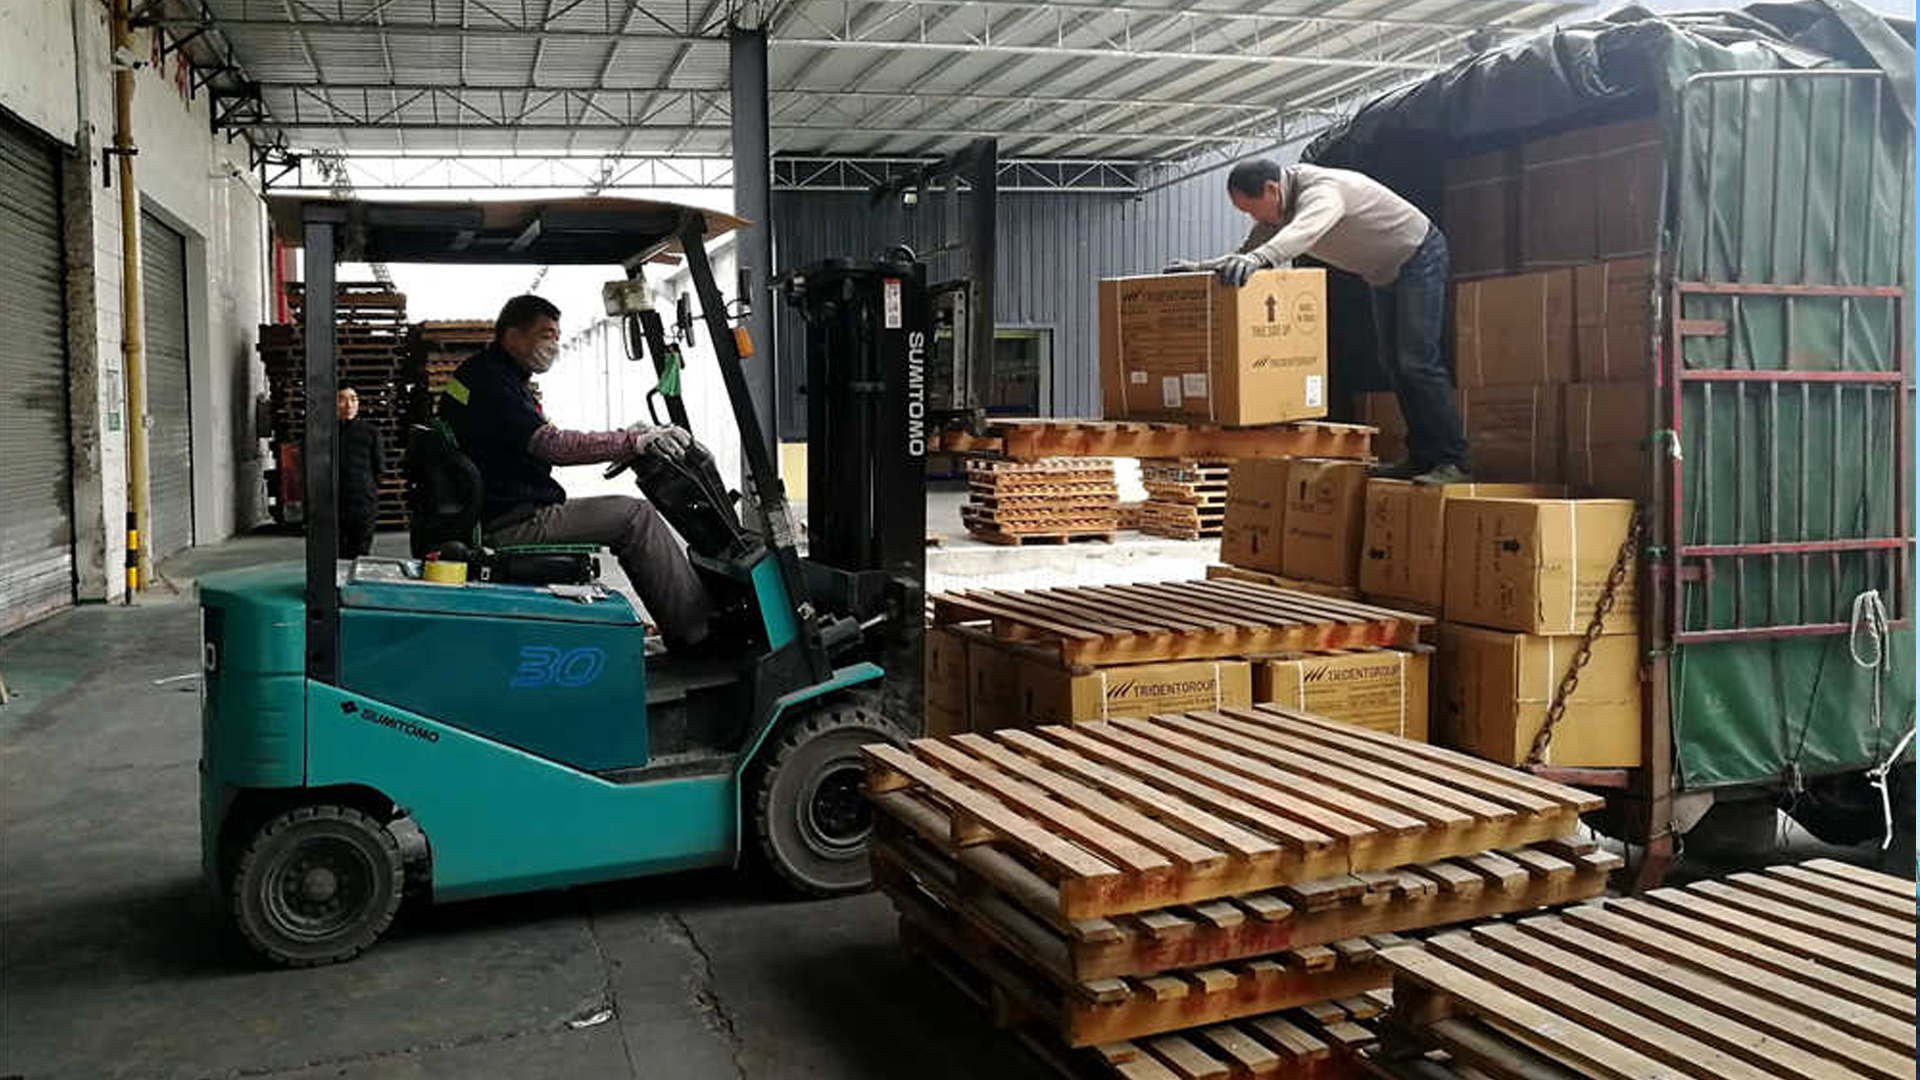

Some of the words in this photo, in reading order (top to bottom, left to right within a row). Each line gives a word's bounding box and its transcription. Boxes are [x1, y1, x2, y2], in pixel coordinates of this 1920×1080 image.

[908, 331, 925, 457] SUMITOMO
[510, 645, 606, 689] 30
[1327, 664, 1400, 681] TRIDENTGROUP
[1133, 678, 1217, 697] TRIDENTGROUP
[361, 708, 440, 743] SUMITOMO
